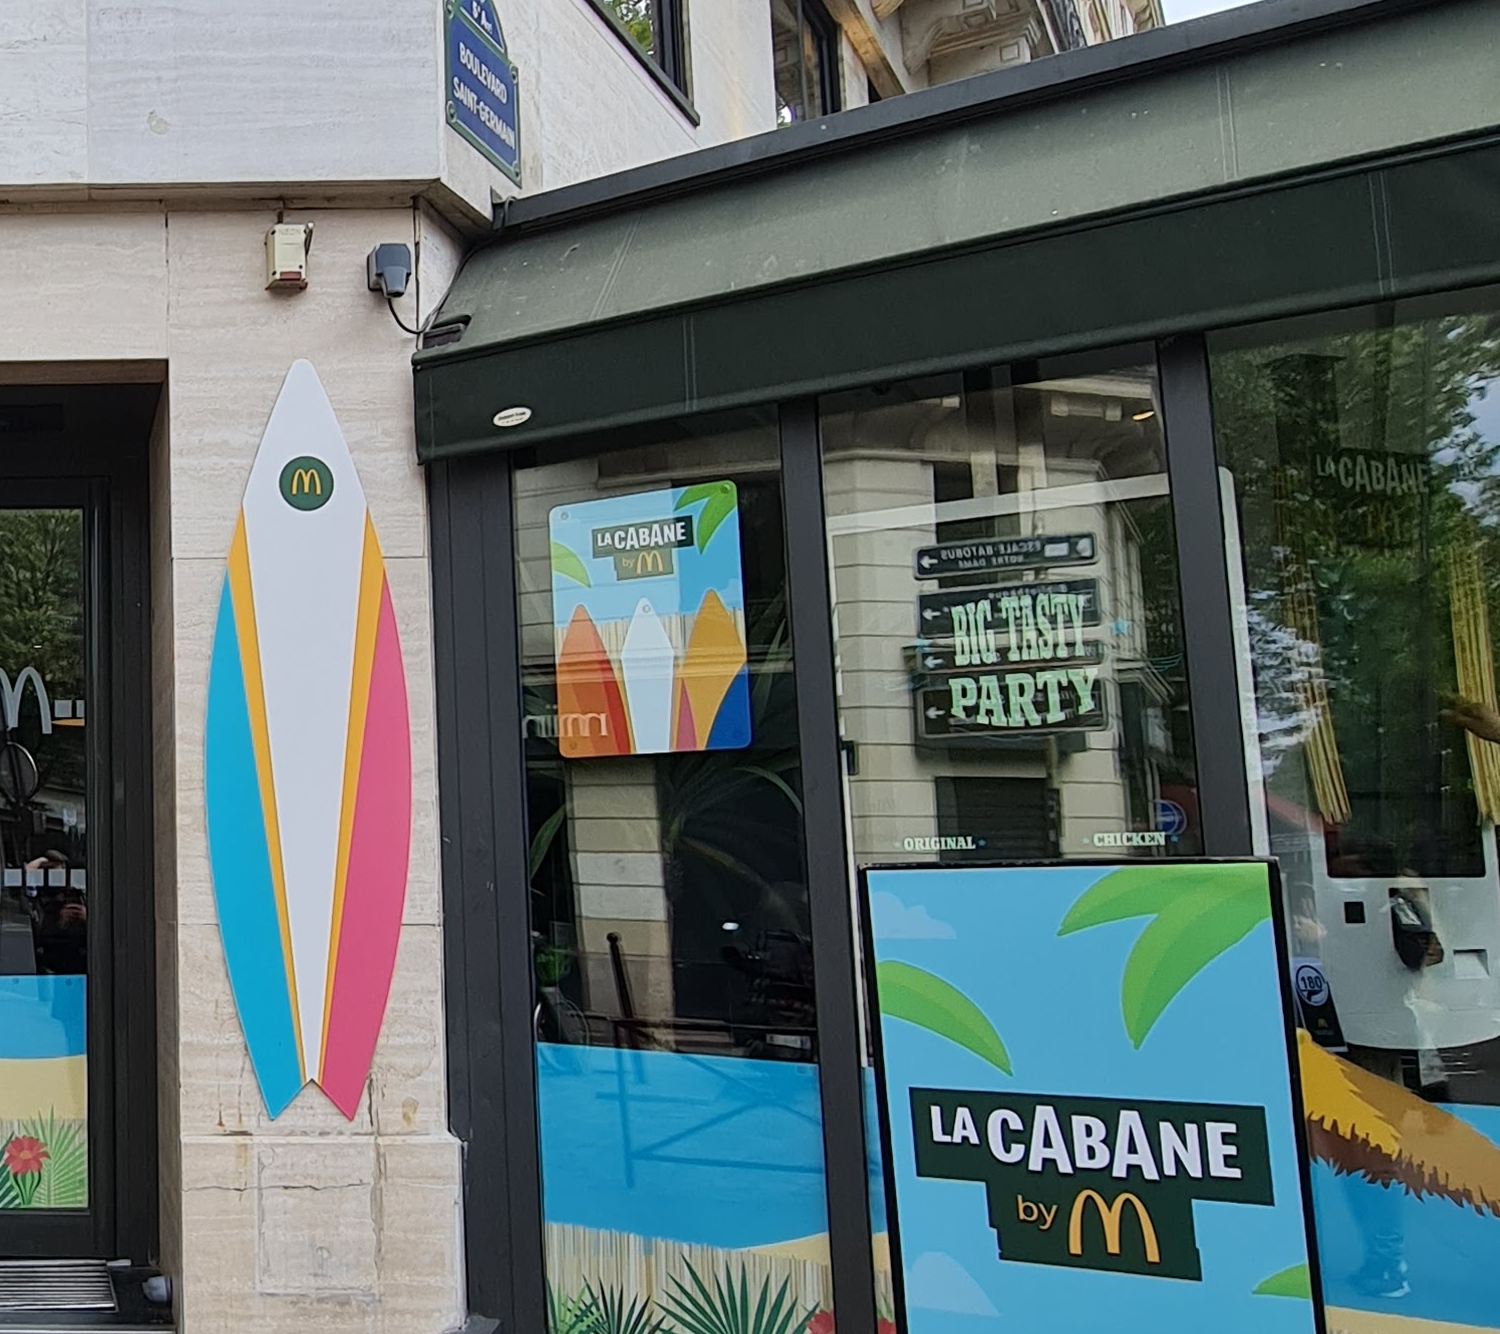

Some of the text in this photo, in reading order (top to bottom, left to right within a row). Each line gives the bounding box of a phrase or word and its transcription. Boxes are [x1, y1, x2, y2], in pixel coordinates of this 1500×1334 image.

[459, 41, 507, 105] BOULEVARD
[453, 77, 515, 150] SAINT-GERMAIN
[1316, 453, 1429, 495] LA CABANE
[597, 522, 686, 551] LA CABANE
[621, 557, 635, 571] by
[951, 593, 1086, 666] BIG TASTY
[948, 667, 1099, 727] PARTY
[903, 835, 976, 850] ORIGINAL
[1092, 831, 1166, 846] CHICKEN
[1300, 975, 1323, 989] 180
[930, 1105, 1242, 1181] LA CABANE
[1016, 1193, 1058, 1230] by
